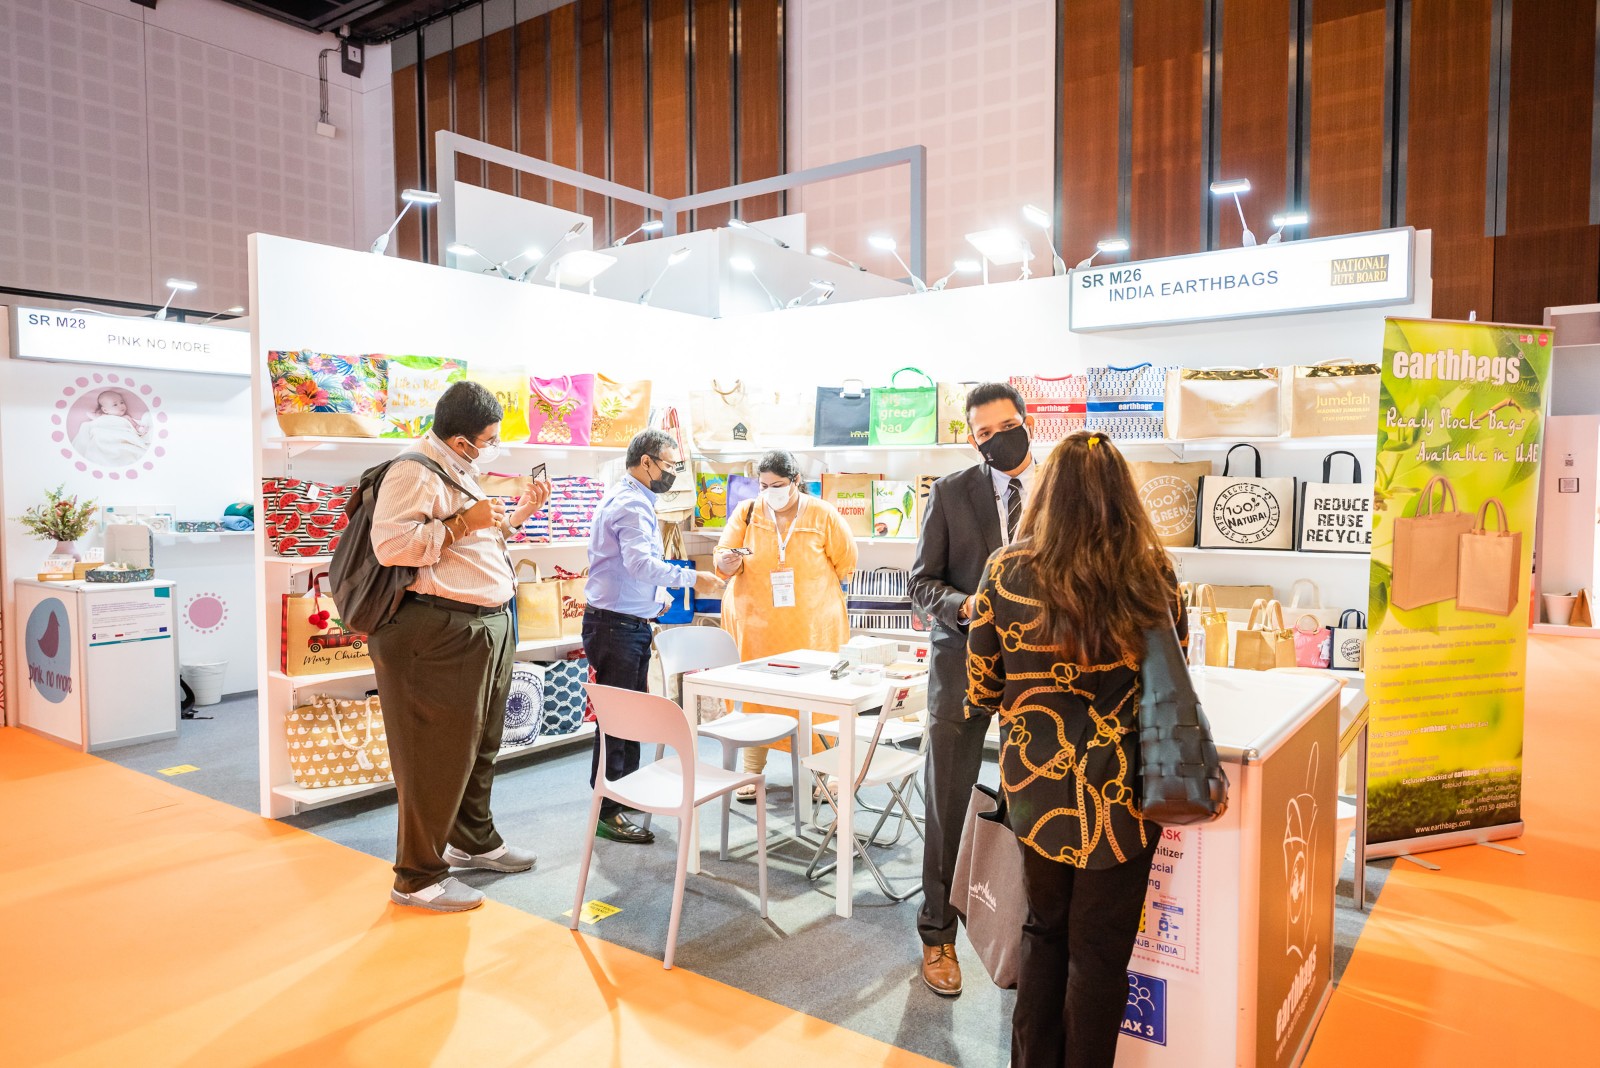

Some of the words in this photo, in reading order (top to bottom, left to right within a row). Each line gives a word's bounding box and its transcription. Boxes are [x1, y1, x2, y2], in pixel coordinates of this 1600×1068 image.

[1333, 255, 1388, 274] NATIONAL
[1081, 273, 1105, 289] SR
[1108, 267, 1143, 286] M26
[1332, 272, 1355, 285] JUTE
[1356, 270, 1387, 283] BOARD
[1108, 284, 1155, 302] INDIA
[1160, 269, 1279, 297] EARTHBAGS
[28, 313, 51, 326] SR
[56, 316, 87, 330] M28
[107, 334, 142, 348] PINK
[146, 338, 167, 350] NO
[171, 340, 211, 354] MORE
[1315, 390, 1370, 409] Jumeirah
[879, 408, 916, 421] green
[1385, 406, 1434, 436] Ready
[1439, 408, 1482, 431] Stock
[1488, 409, 1526, 437] Bags
[880, 422, 903, 435] bag
[1416, 441, 1487, 462] Available
[1493, 448, 1509, 462] in
[1515, 443, 1539, 463] UAE
[837, 491, 865, 499] EMS
[1313, 497, 1370, 512] REDUCE
[1317, 513, 1364, 528] REUSE
[1306, 529, 1372, 545] RECYCLE
[303, 655, 331, 666] Merry
[29, 661, 45, 689] pink
[46, 670, 55, 688] no
[56, 673, 72, 694] more
[1402, 777, 1426, 785] Exclusive
[1426, 773, 1448, 782] Stockist
[1414, 819, 1471, 834] www.earthbags.com
[1161, 829, 1182, 842] ASK
[1150, 862, 1174, 875] ocial
[1156, 943, 1178, 956] INDIA
[1121, 1017, 1142, 1034] AX
[1145, 1024, 1155, 1037] 3
